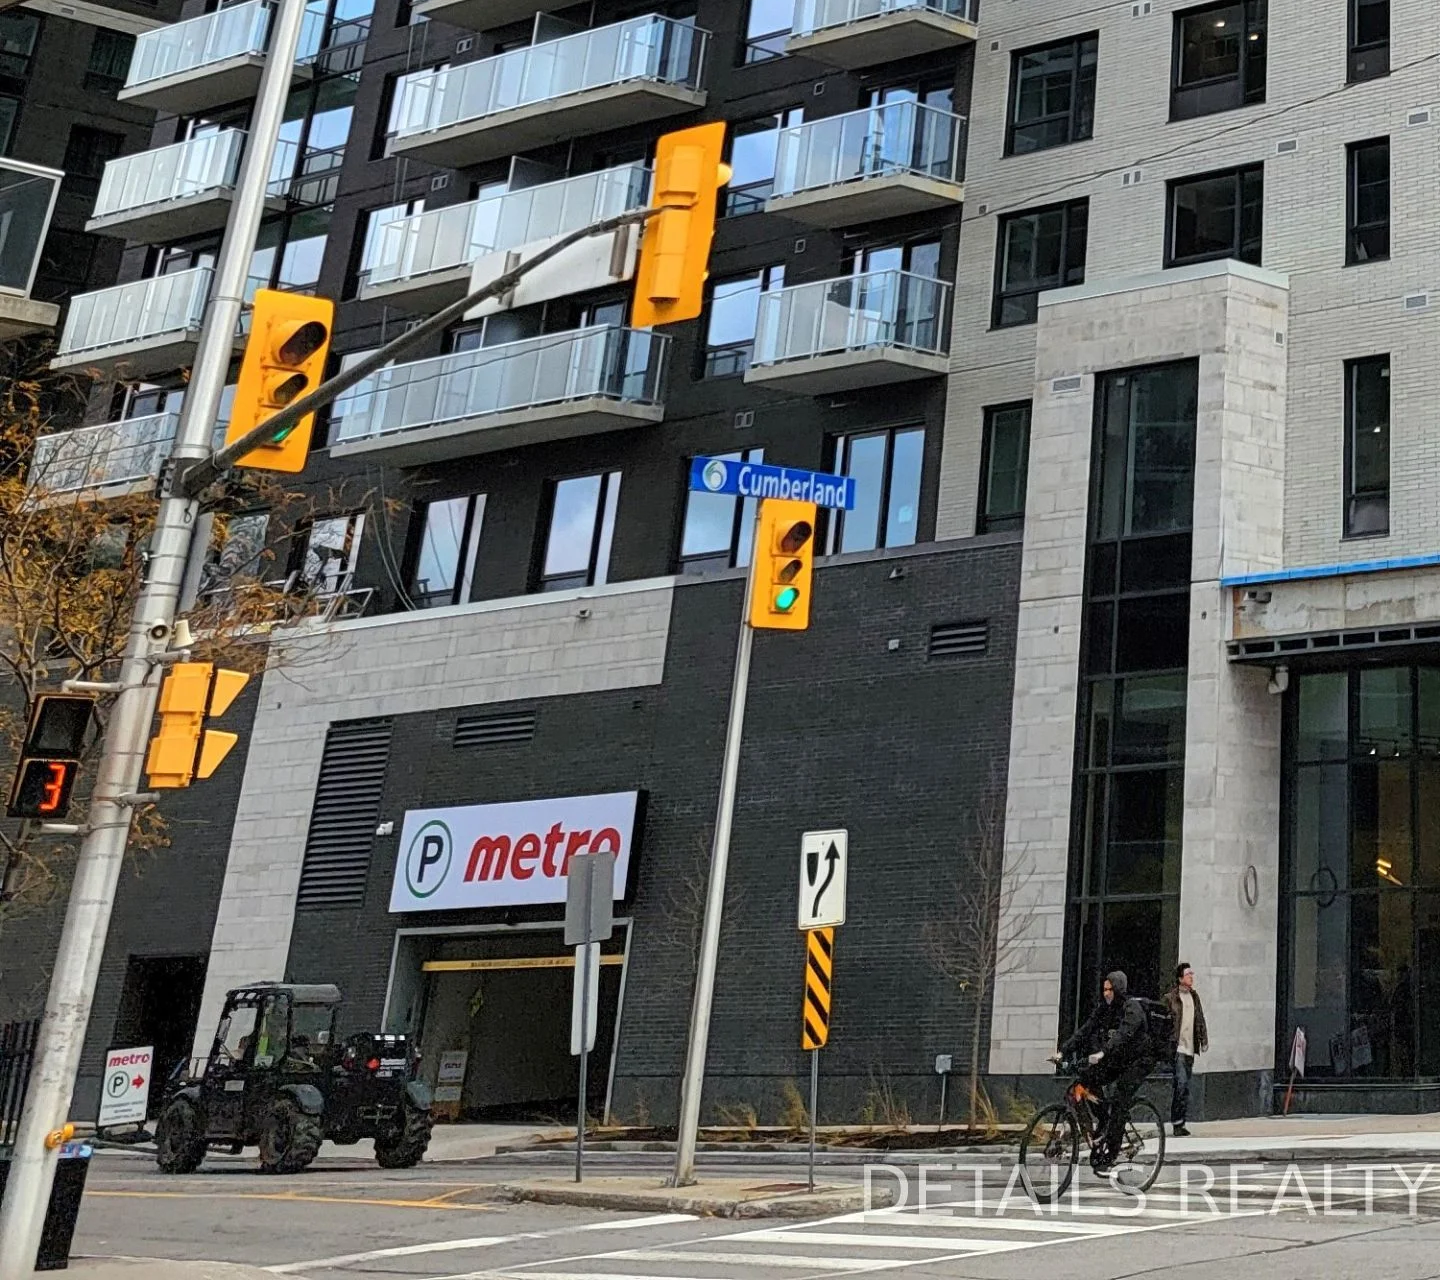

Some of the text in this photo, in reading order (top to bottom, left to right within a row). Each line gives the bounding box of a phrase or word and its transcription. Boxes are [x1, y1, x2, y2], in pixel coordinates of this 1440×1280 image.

[739, 466, 847, 508] Cumberland
[39, 762, 66, 810] 3
[416, 821, 621, 883] P metro
[108, 1053, 150, 1067] metro
